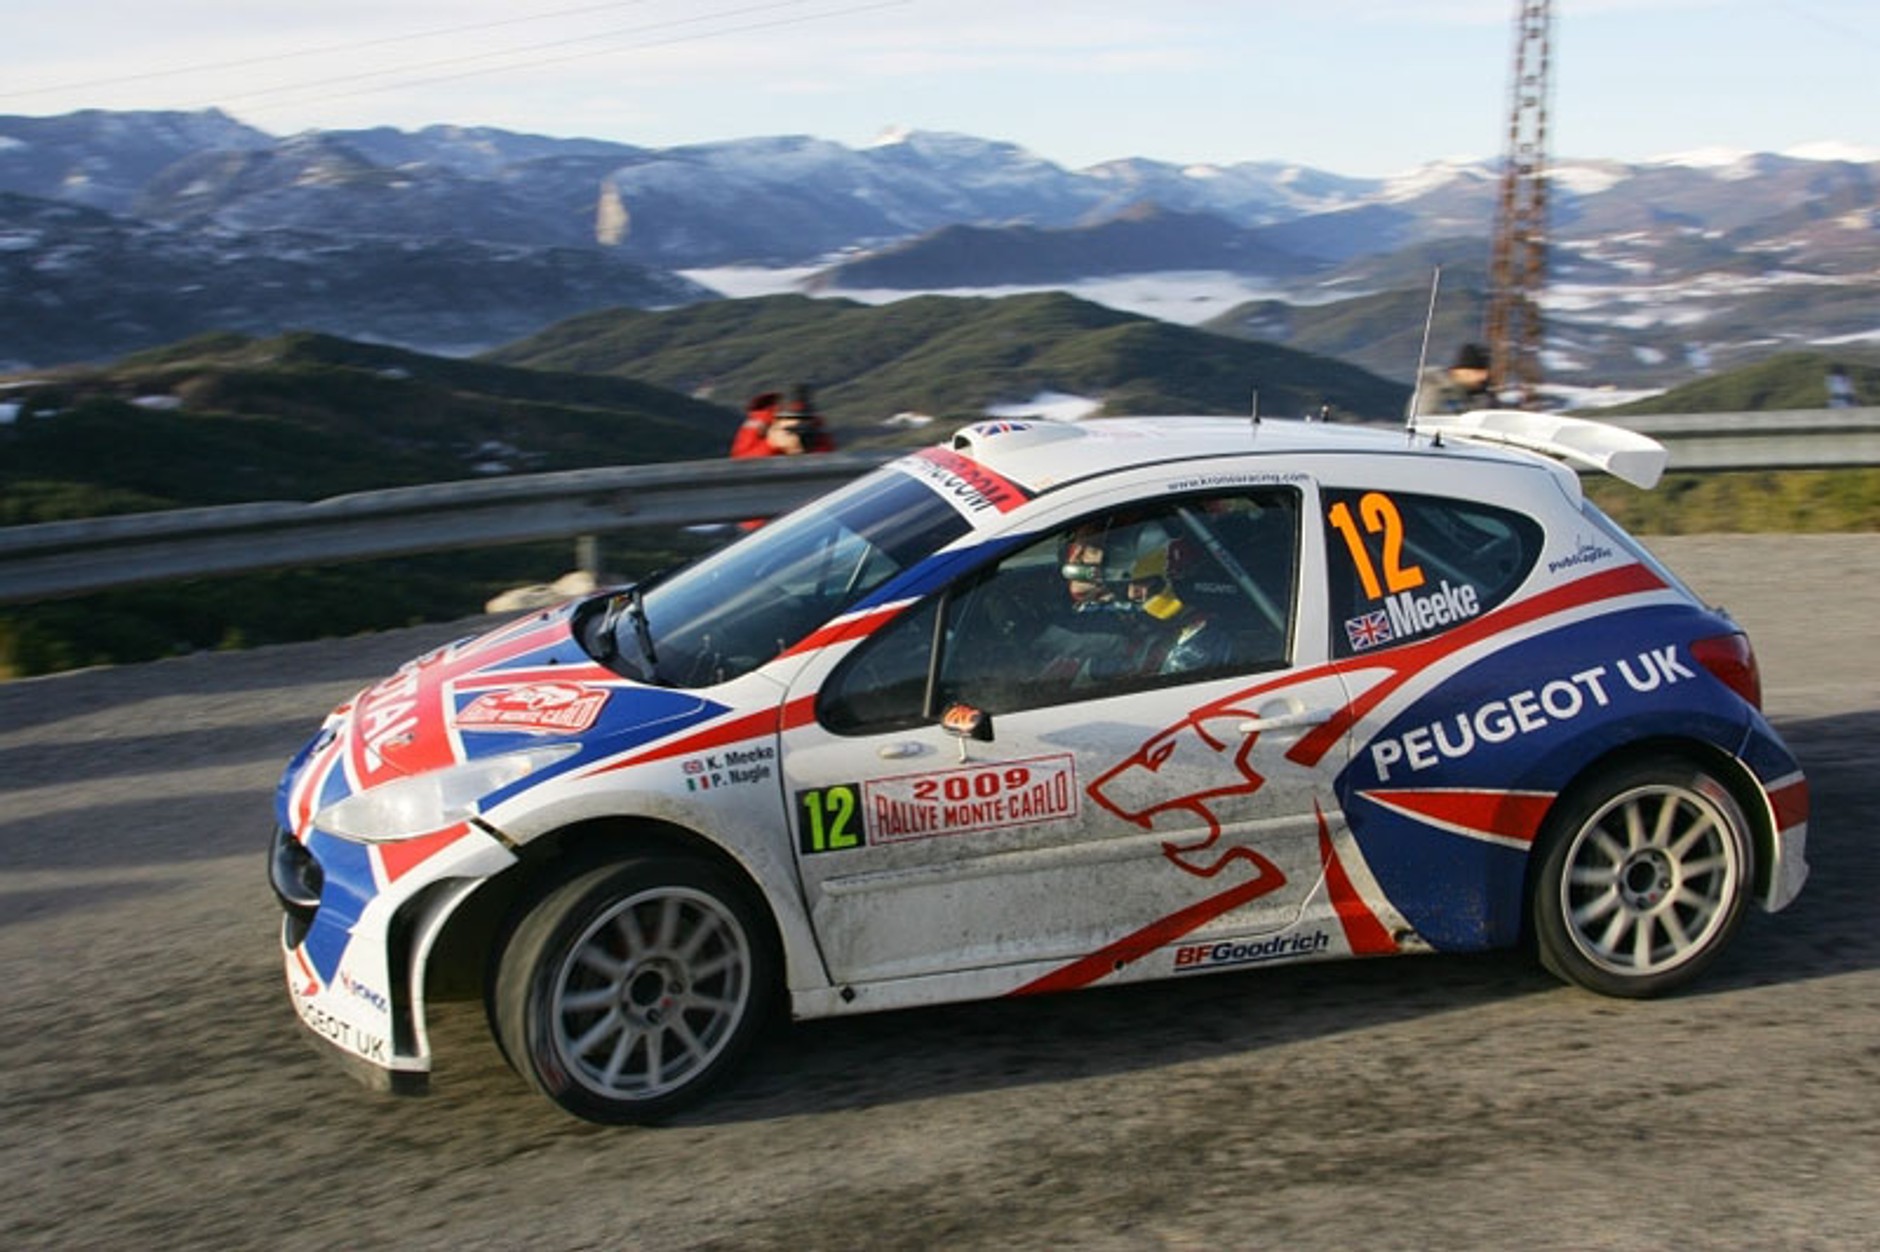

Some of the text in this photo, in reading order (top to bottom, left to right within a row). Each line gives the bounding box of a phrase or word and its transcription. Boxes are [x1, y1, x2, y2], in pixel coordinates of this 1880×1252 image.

[1328, 492, 1426, 600] 12
[1385, 580, 1480, 638] Meeke
[1371, 644, 1697, 782] PEUGEOT UK
[725, 746, 775, 766] Meeke
[729, 764, 770, 784] Nagle
[913, 767, 1030, 801] 2009
[803, 786, 858, 850] 12
[875, 794, 938, 838] RALLYE
[1174, 930, 1329, 967] BFGoodrich
[356, 1029, 386, 1062] UK
